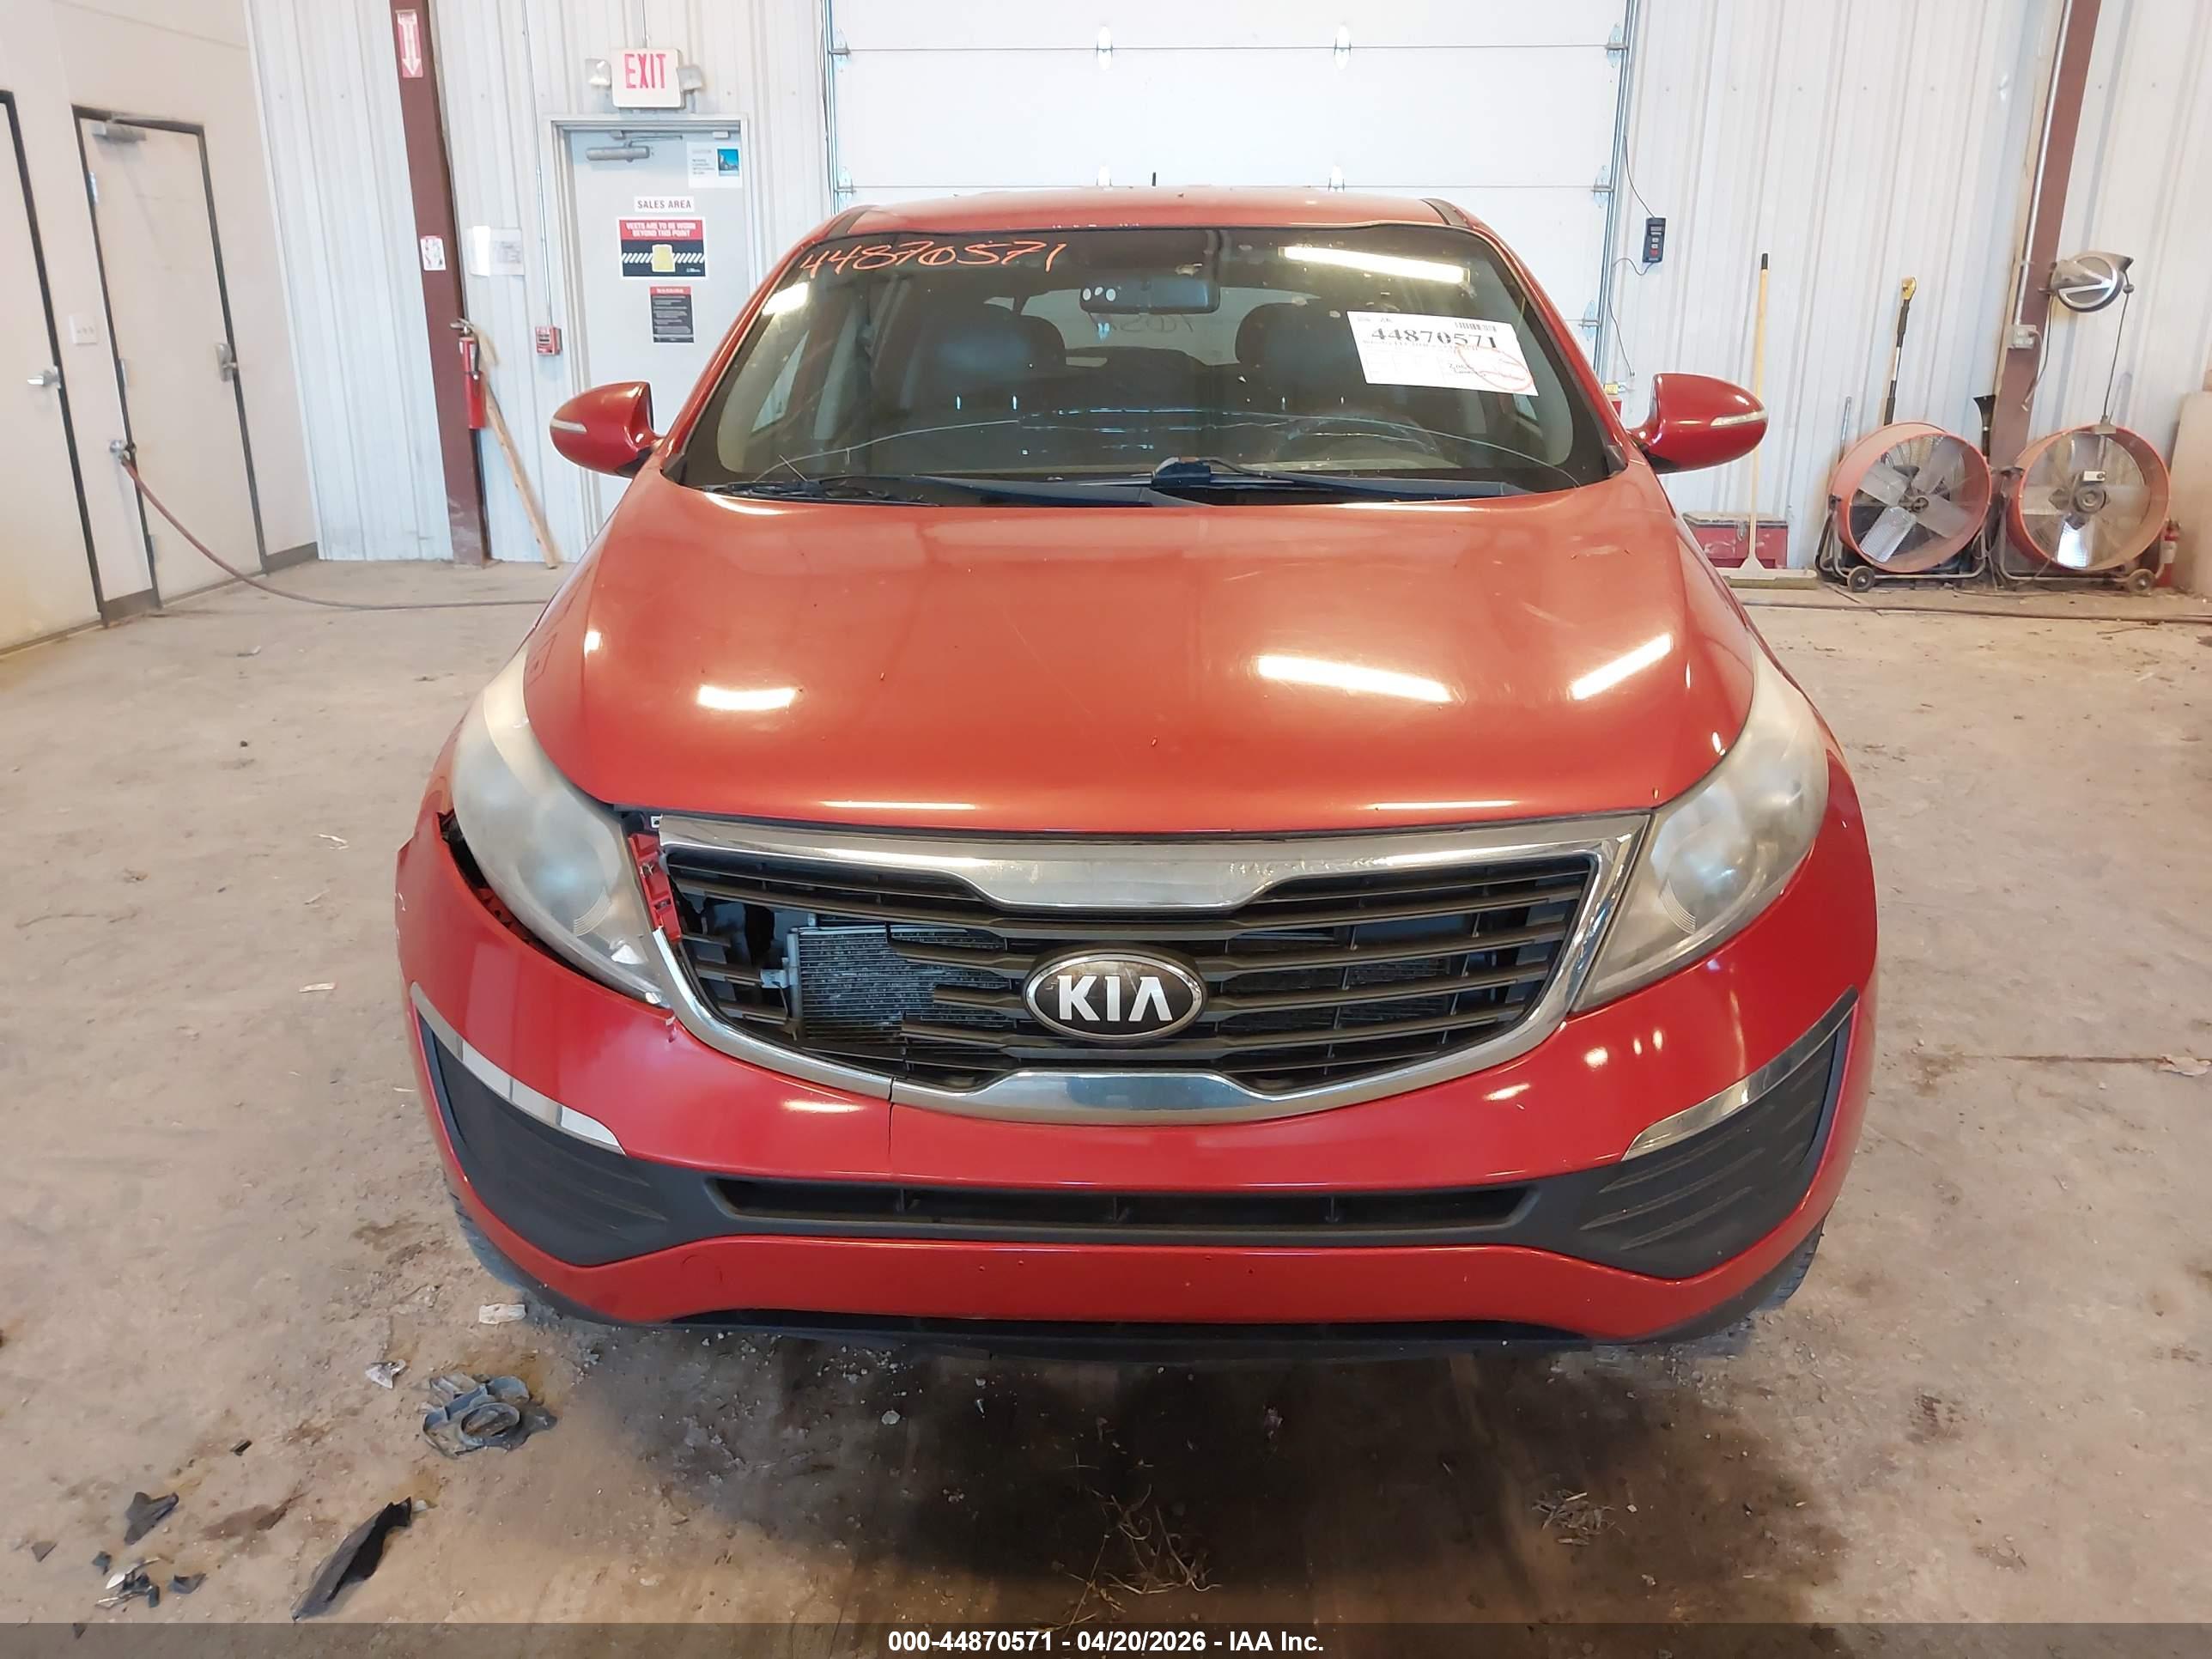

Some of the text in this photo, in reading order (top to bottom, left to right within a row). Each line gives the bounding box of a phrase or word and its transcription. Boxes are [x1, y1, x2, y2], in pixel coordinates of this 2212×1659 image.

[624, 53, 666, 89] EXIT
[637, 199, 691, 210] SALES AREA
[799, 240, 1068, 279] 44870571
[1370, 327, 1498, 349] 44870571
[1056, 975, 1174, 1022] KIA
